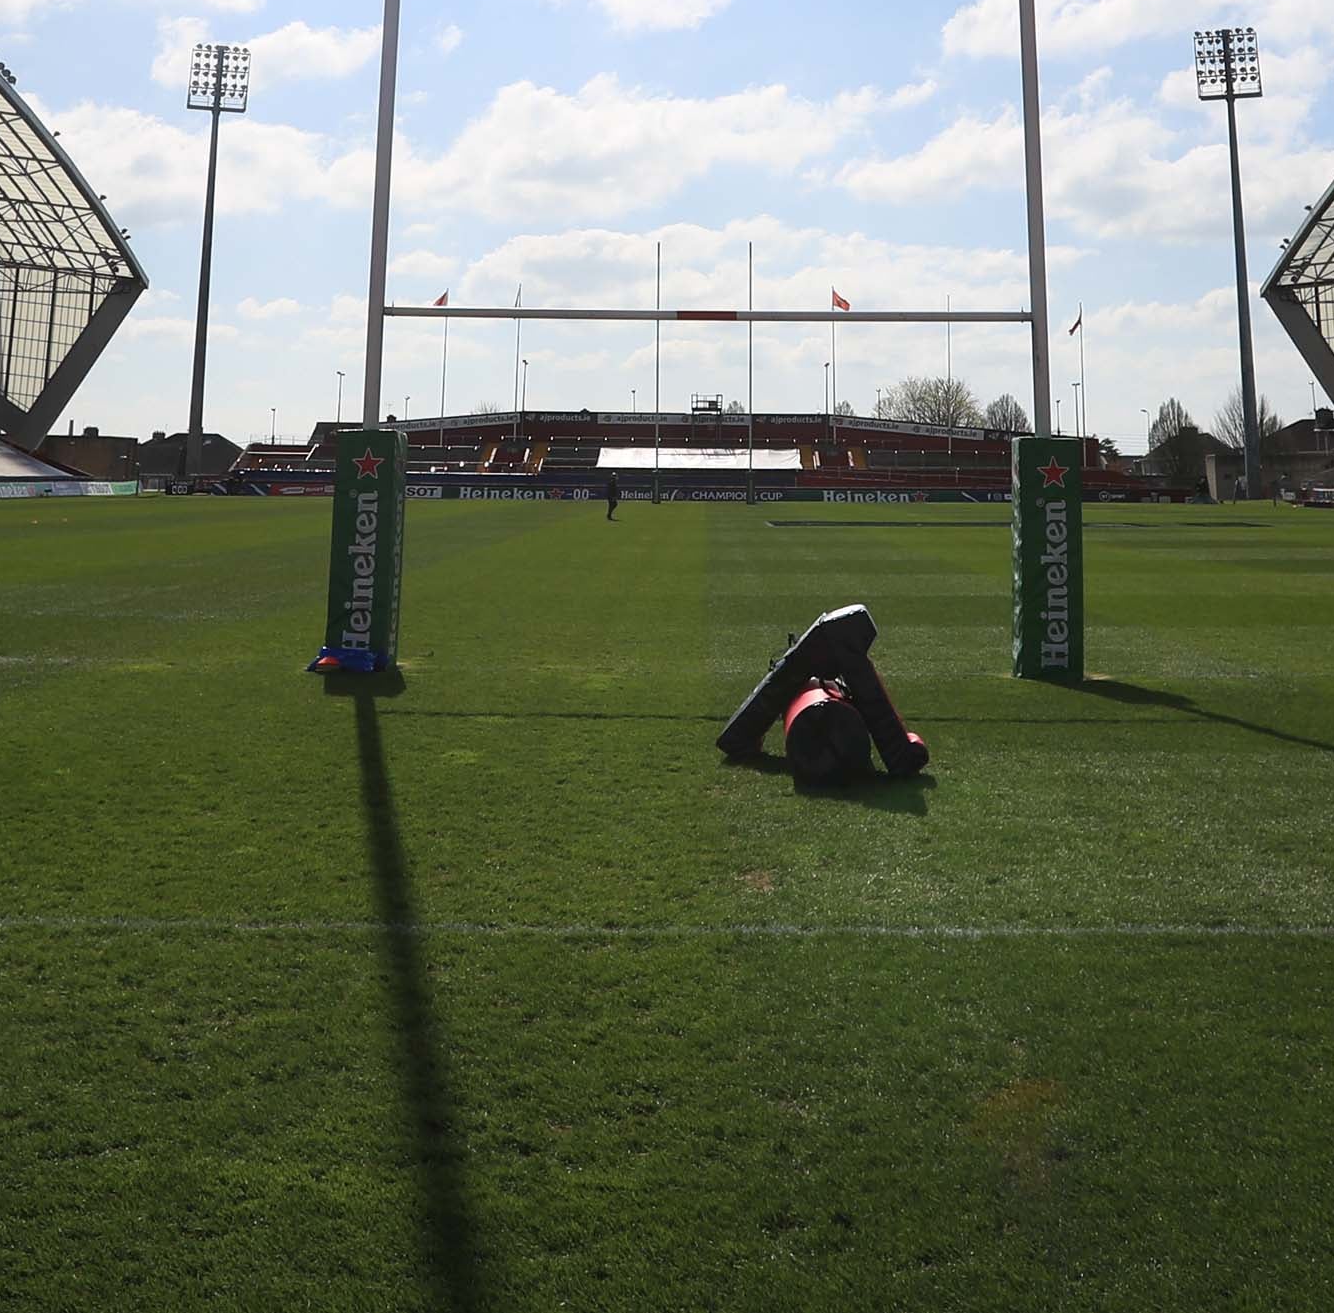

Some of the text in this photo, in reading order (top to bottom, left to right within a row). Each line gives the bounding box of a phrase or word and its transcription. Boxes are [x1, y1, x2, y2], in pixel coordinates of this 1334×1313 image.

[463, 415, 517, 426] ajproducts.ie
[539, 414, 591, 424] ajproducts.ie
[770, 416, 823, 425] ajproducts.ie
[849, 420, 899, 431] ajproducts.ie
[406, 487, 438, 497] SOT
[459, 487, 545, 500] Heineken
[760, 492, 783, 501] CUP
[822, 490, 910, 503] Heineken
[341, 491, 378, 651] Heineken
[1040, 499, 1068, 669] Heineken
